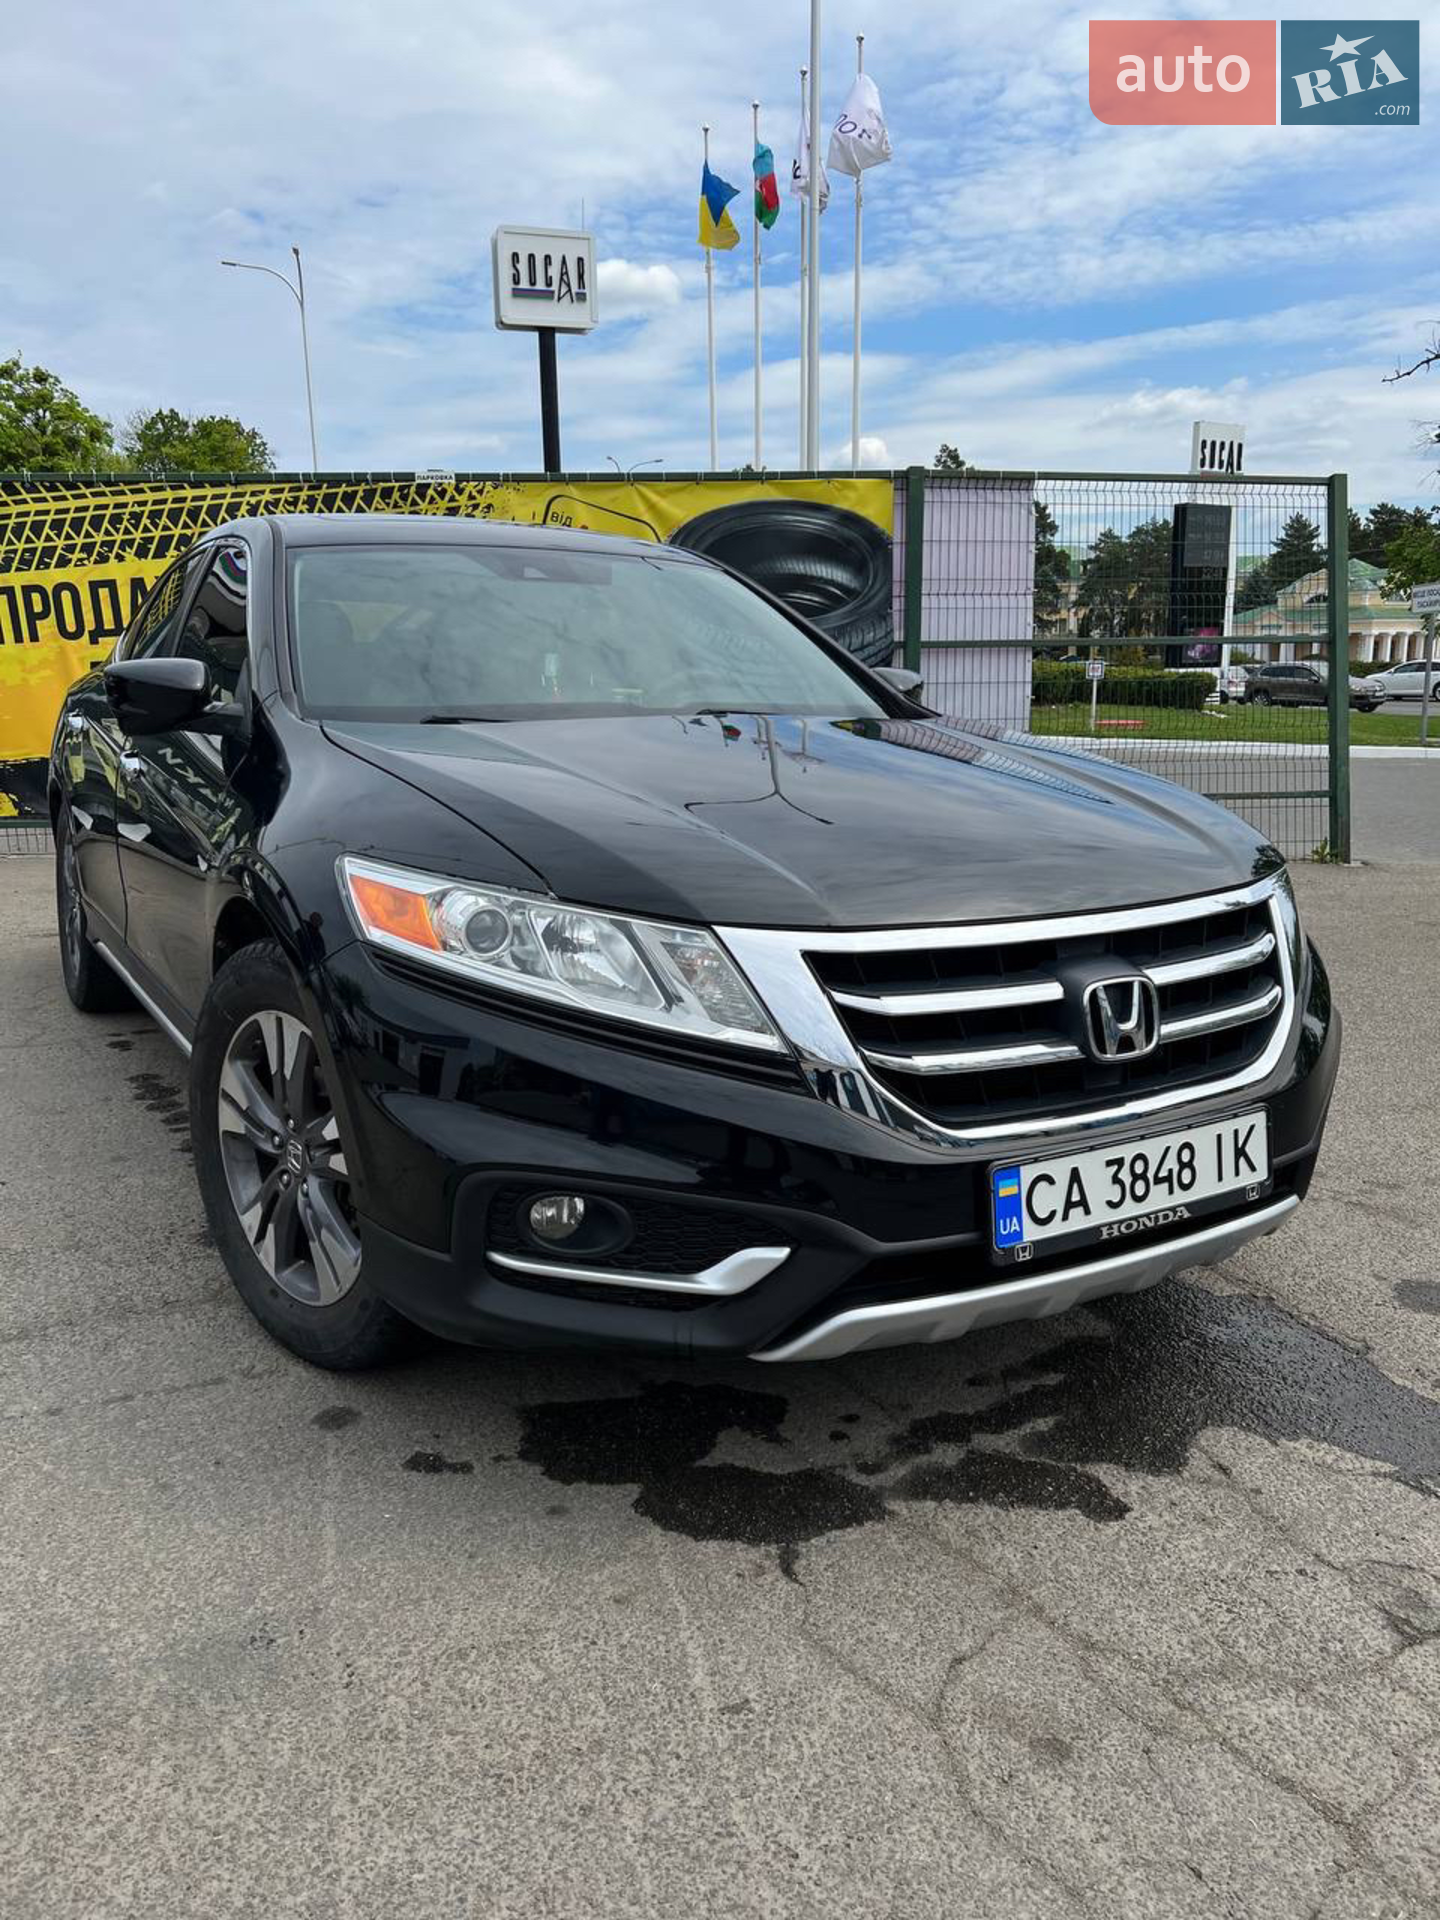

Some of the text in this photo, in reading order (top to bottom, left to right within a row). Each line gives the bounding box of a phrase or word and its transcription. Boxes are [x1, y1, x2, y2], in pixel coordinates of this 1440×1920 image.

[511, 251, 586, 303] SOCAR
[1026, 1124, 1257, 1226] CA 3848 IK
[1000, 1216, 1020, 1235] UA
[1100, 1206, 1192, 1239] HONDA
